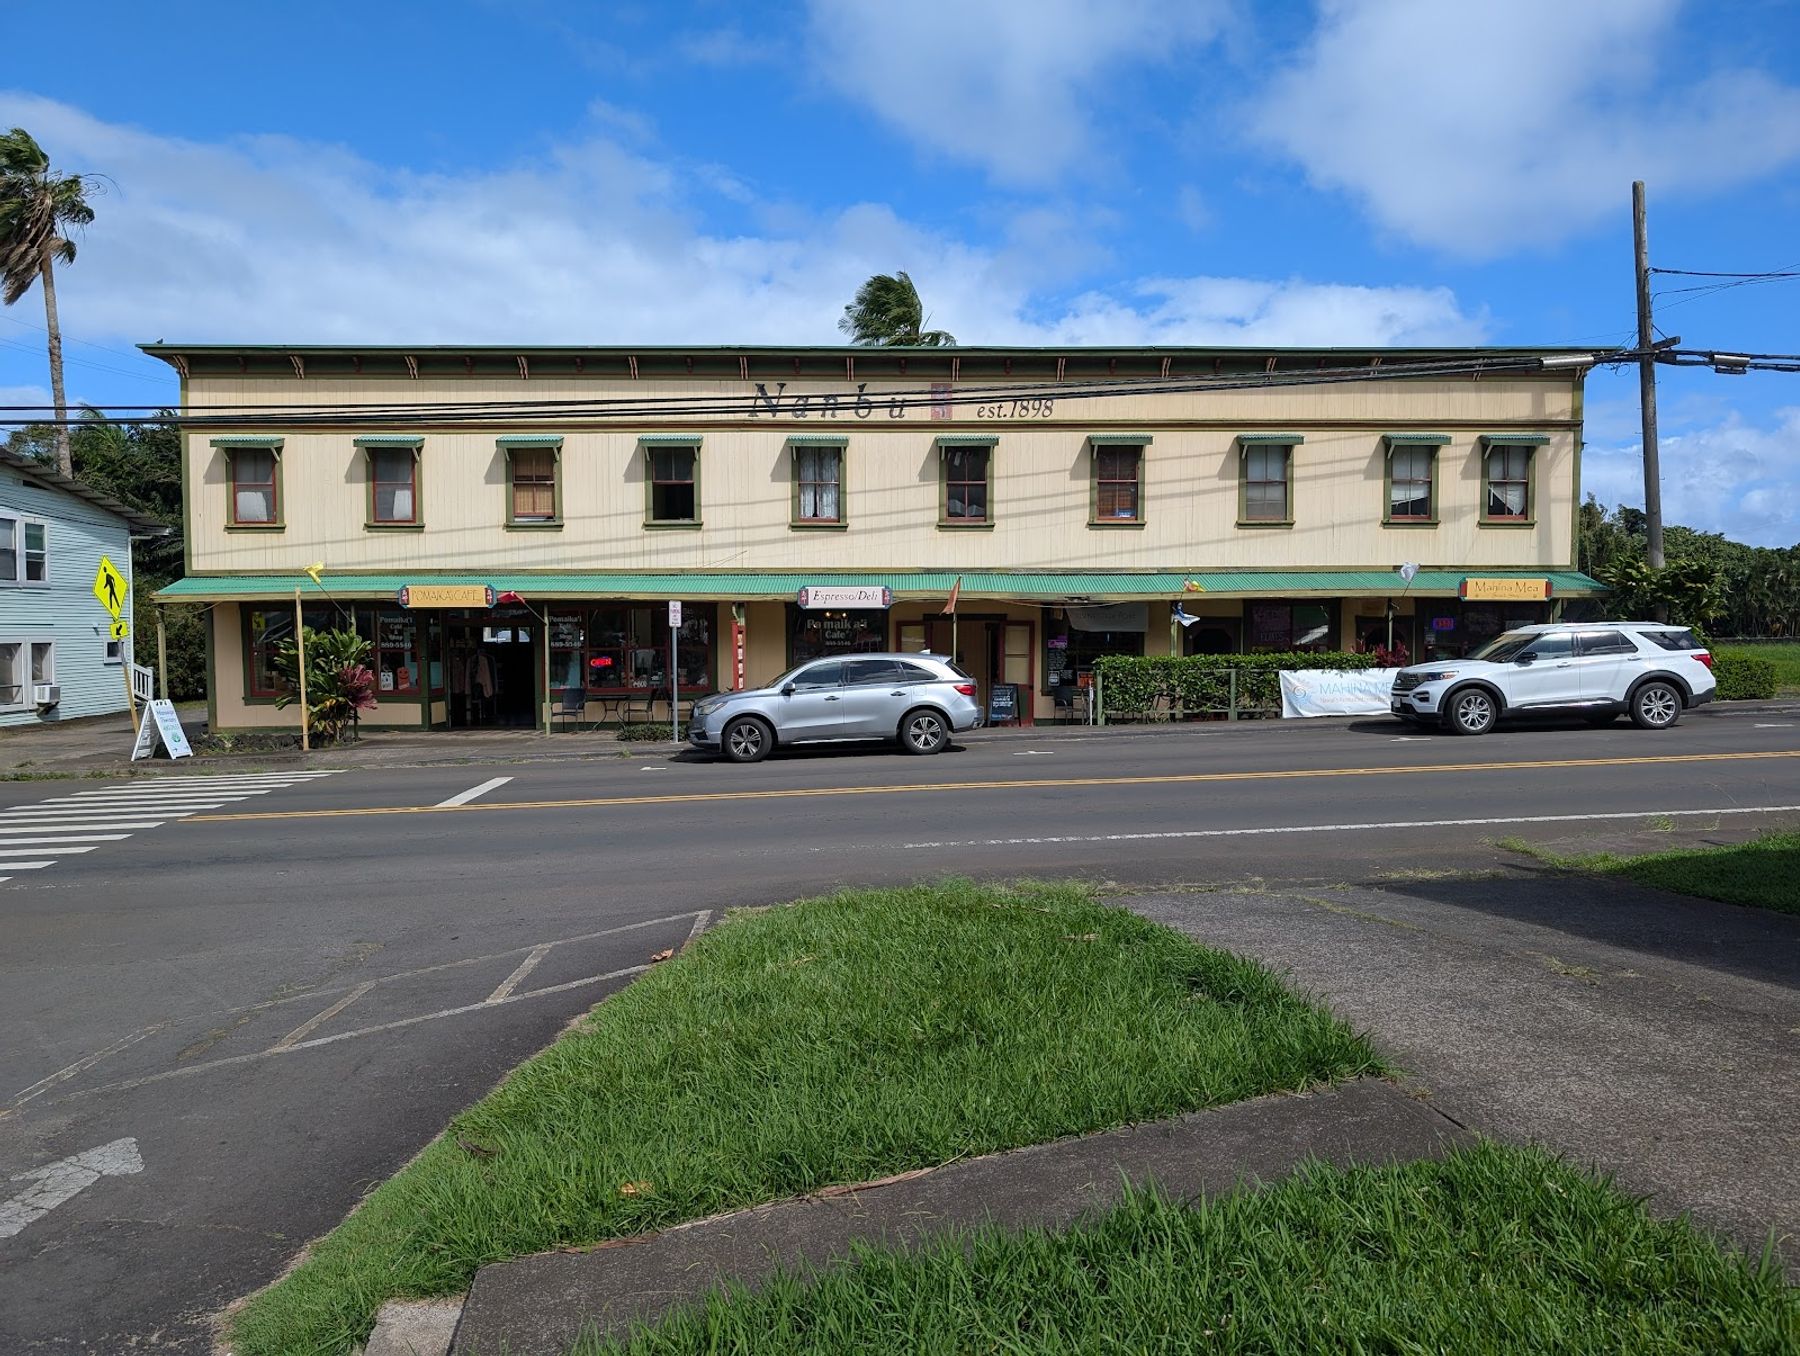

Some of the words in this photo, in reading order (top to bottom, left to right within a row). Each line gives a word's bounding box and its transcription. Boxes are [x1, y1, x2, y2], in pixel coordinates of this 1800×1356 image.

[748, 383, 905, 418] Nanbu
[1475, 581, 1513, 593] Mahina
[1514, 581, 1539, 593] Mea
[1319, 682, 1373, 695] MAHINA
